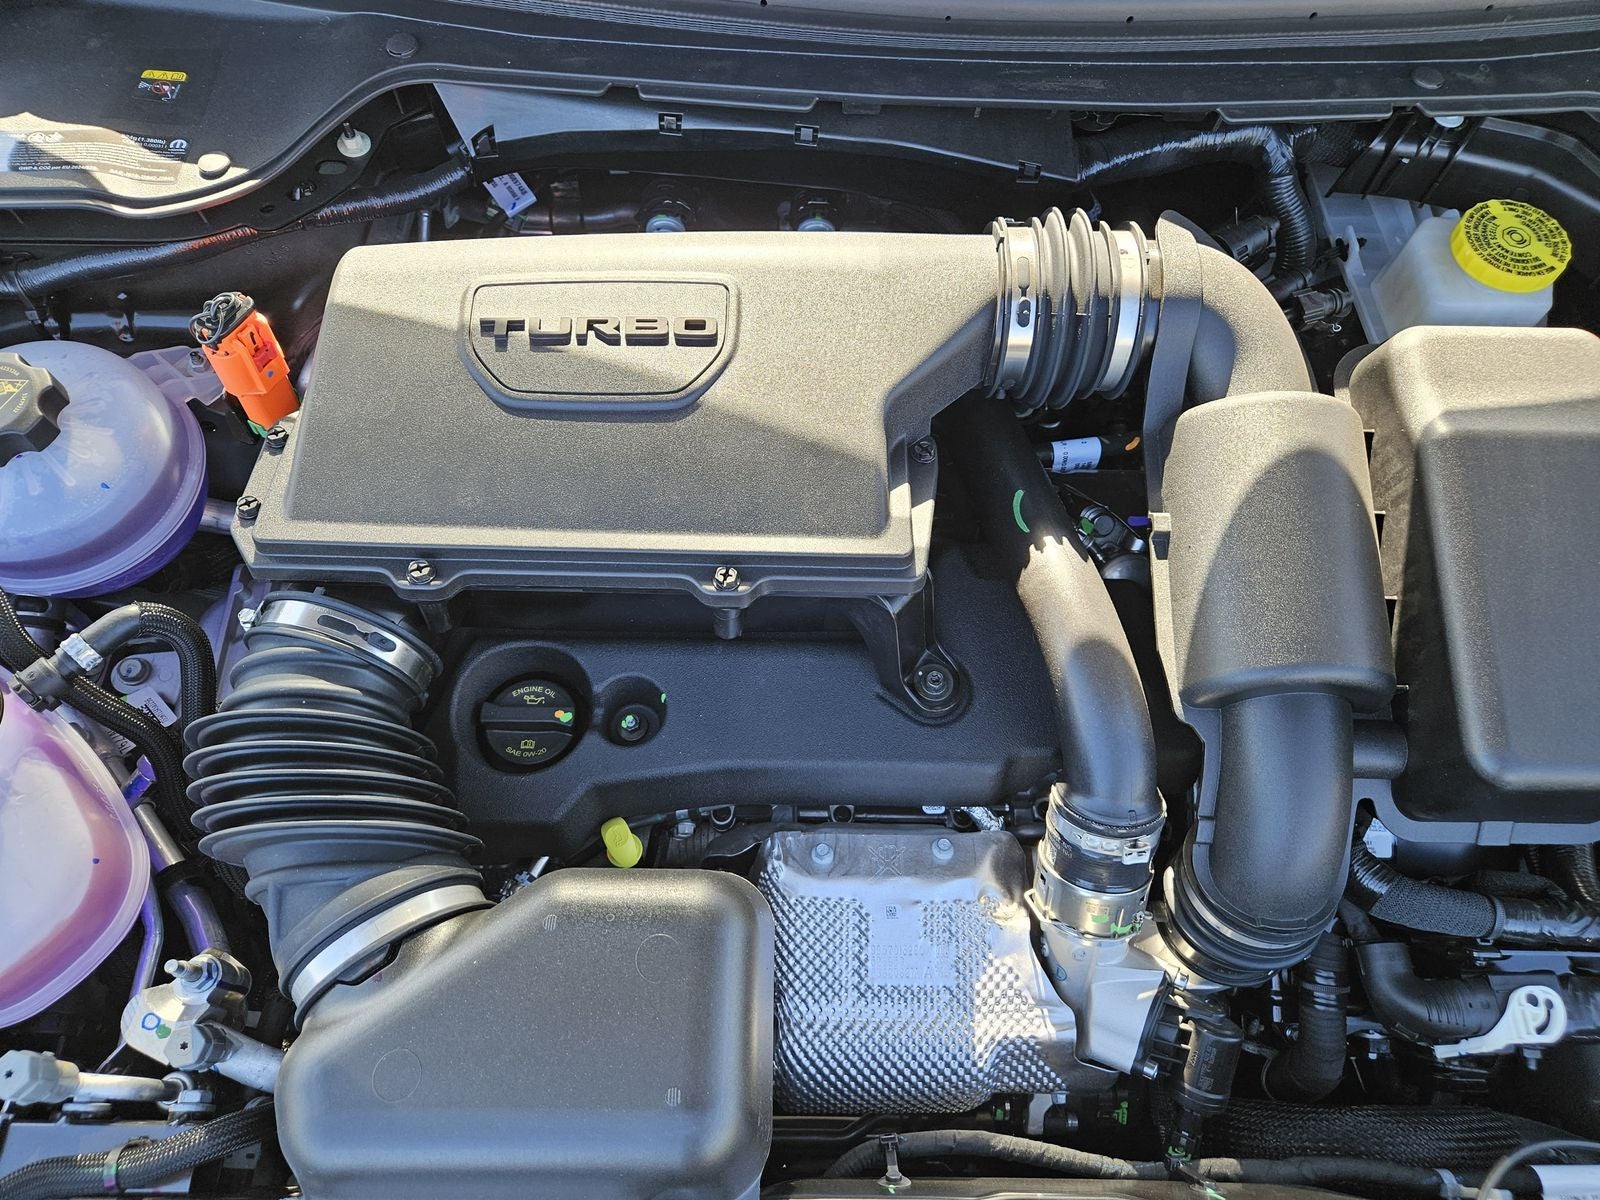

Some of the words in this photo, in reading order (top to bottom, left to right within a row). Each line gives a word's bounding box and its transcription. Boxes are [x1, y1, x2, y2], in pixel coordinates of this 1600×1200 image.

[480, 317, 718, 346] TURBO
[512, 686, 544, 697] ENGINE
[545, 688, 558, 699] OIL
[505, 746, 521, 757] SAE
[522, 747, 547, 757] 0W-20
